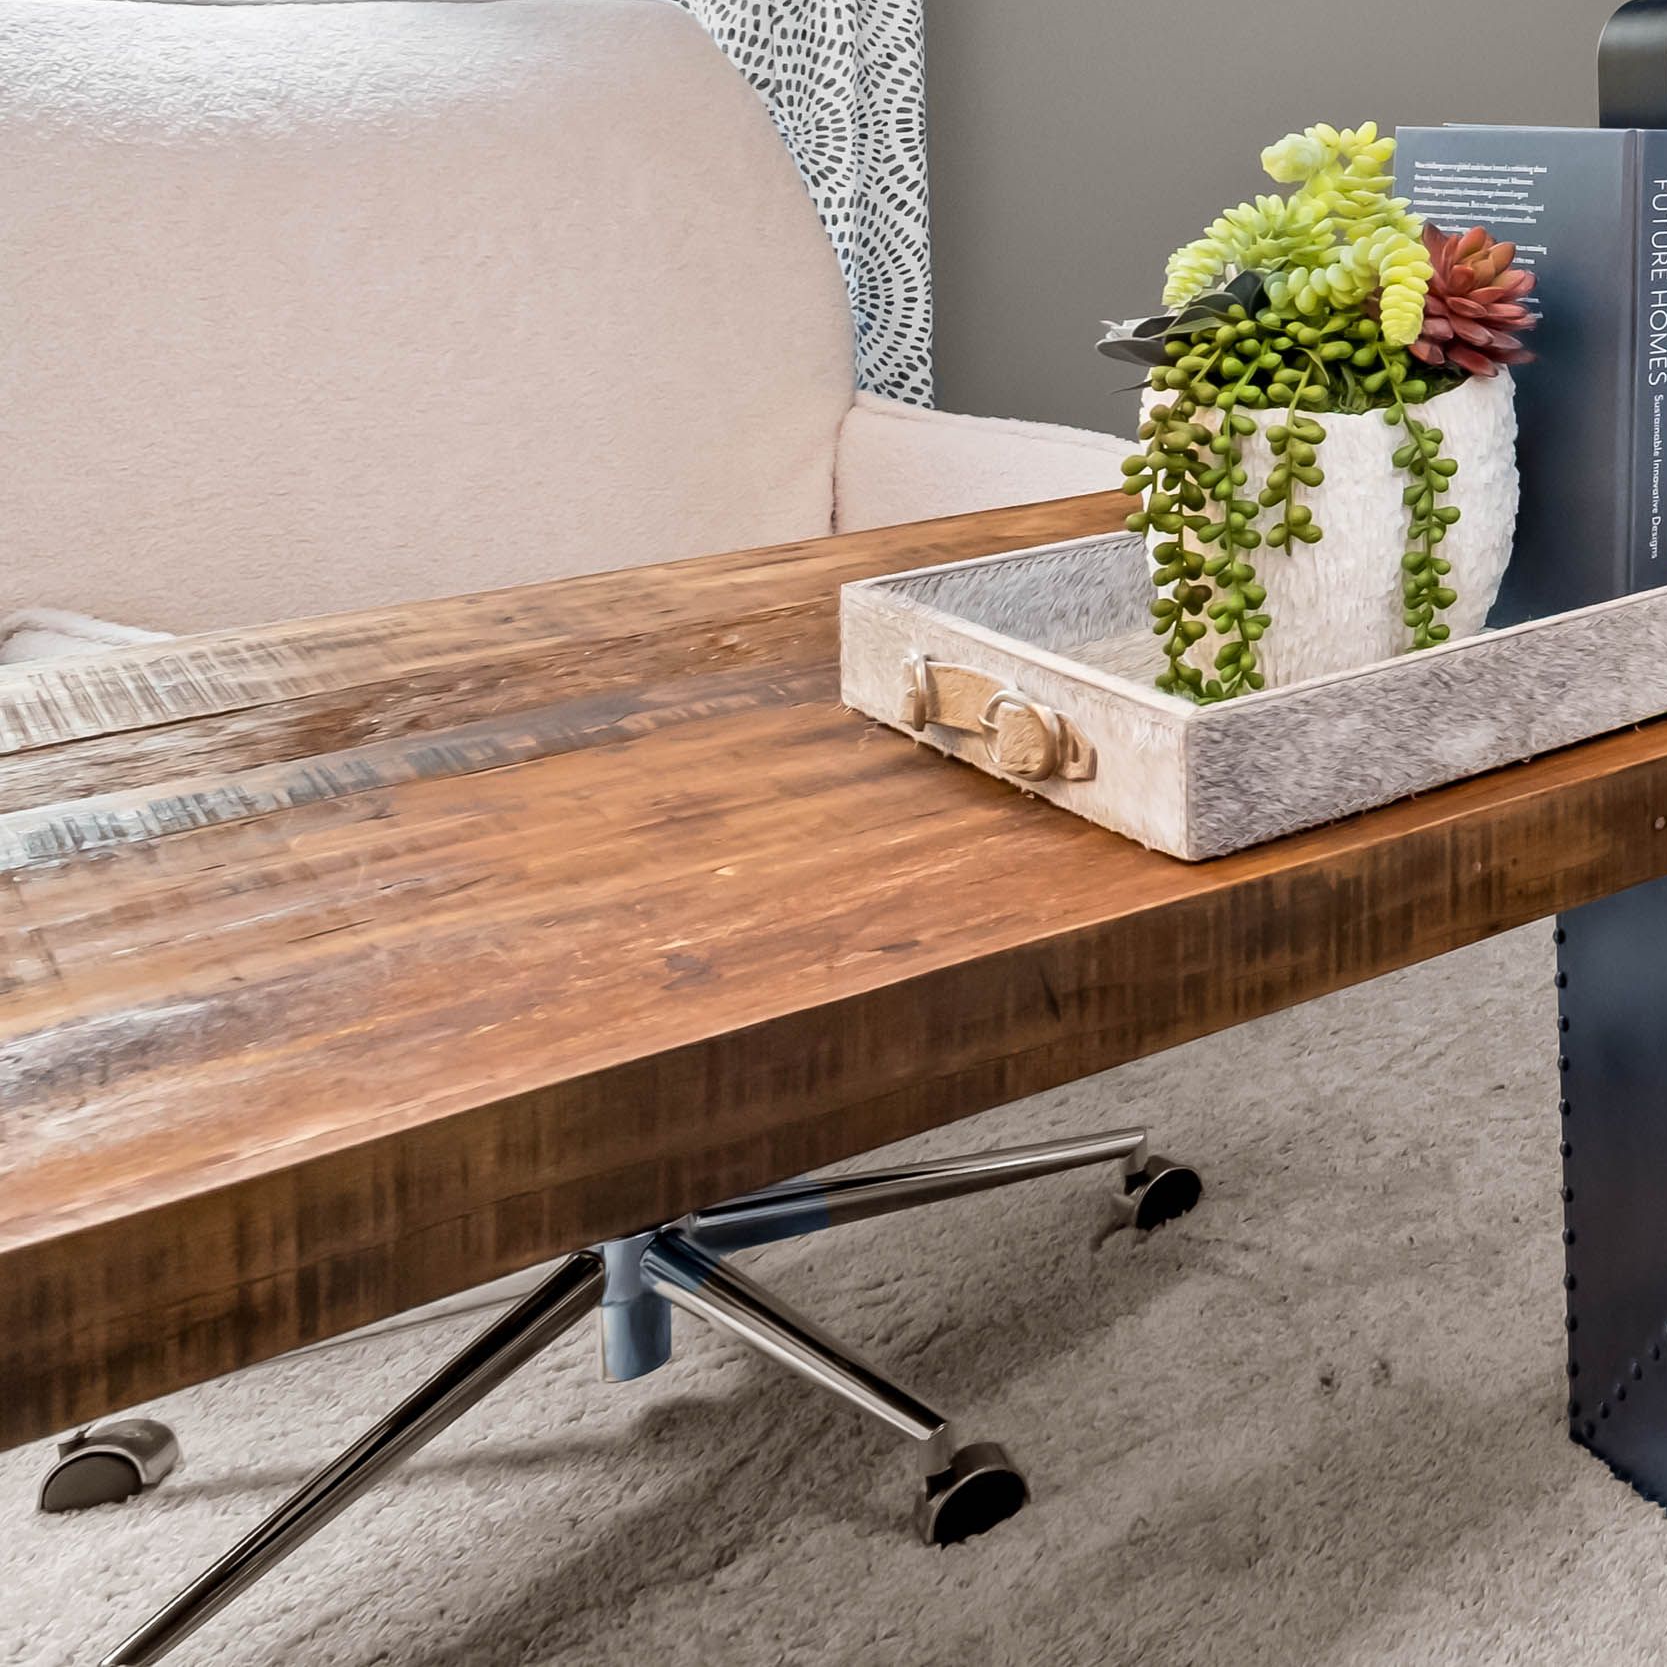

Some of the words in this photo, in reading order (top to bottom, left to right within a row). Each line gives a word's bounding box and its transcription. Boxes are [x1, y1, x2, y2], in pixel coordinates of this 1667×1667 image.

[1653, 394, 1665, 457] Sustainable
[1651, 459, 1663, 514] Innovative
[1649, 516, 1662, 560] Designs
